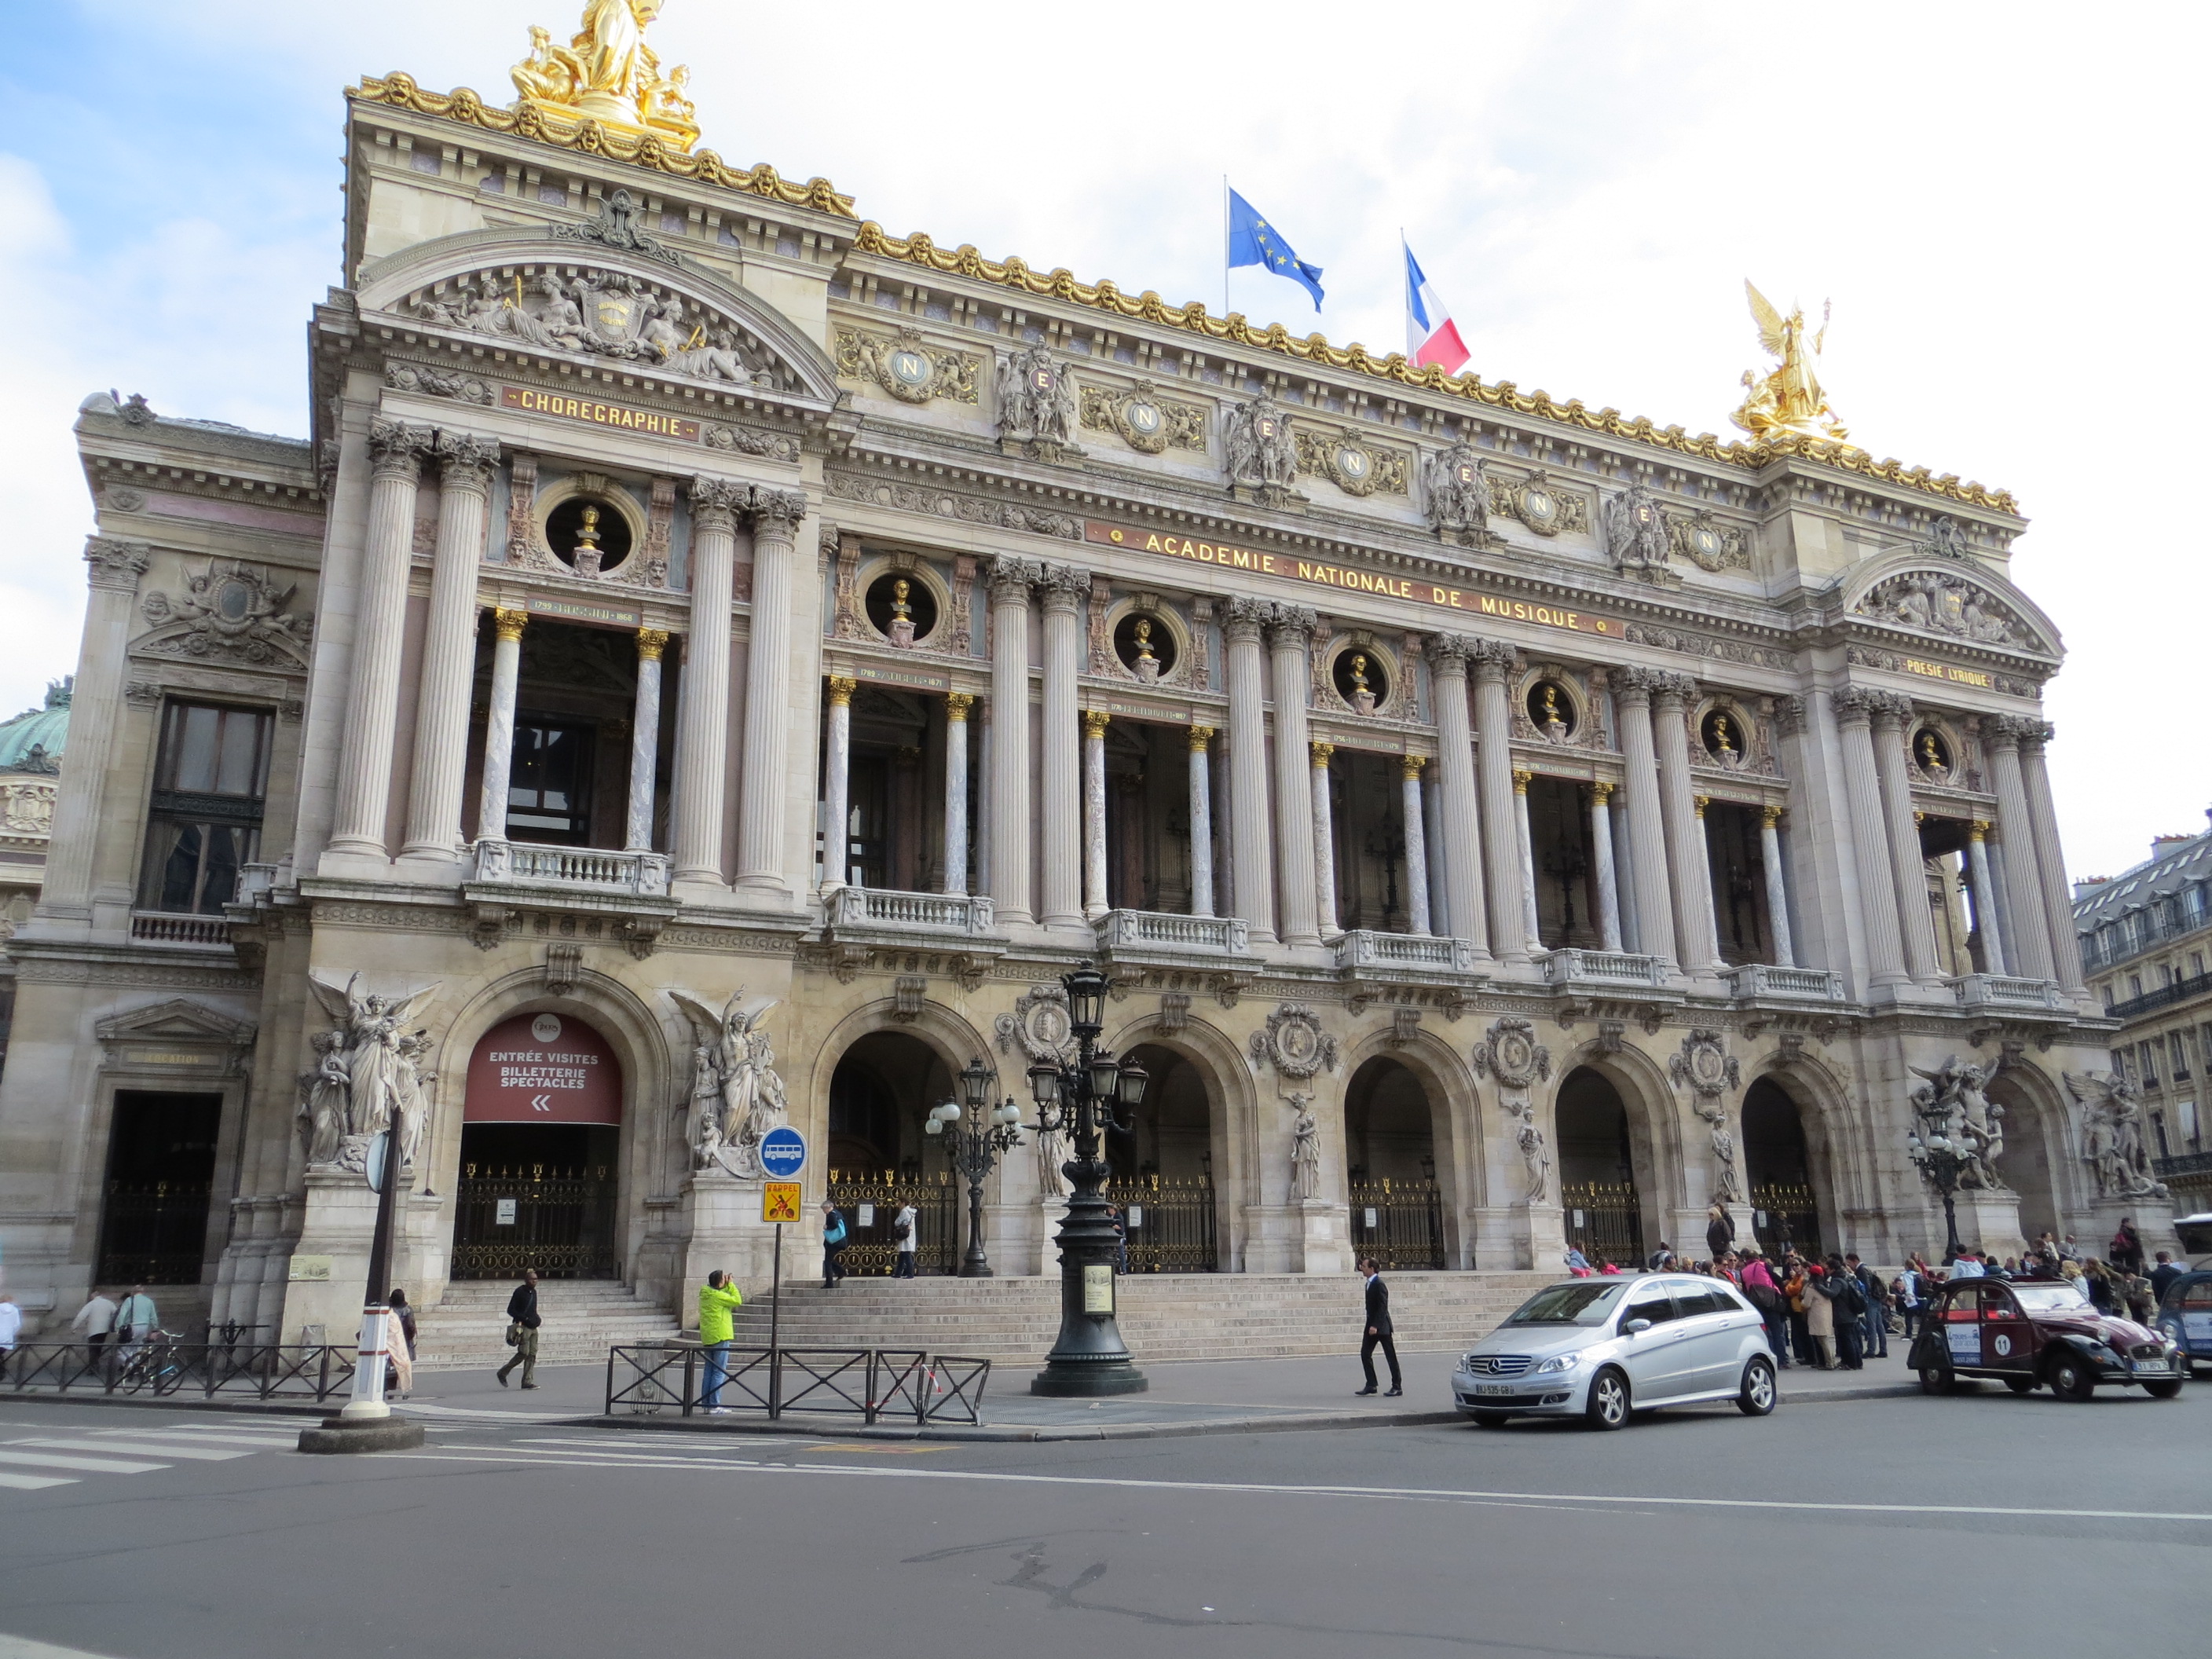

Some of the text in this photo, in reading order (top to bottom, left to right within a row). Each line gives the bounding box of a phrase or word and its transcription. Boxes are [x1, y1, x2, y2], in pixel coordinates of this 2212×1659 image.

[903, 357, 917, 375] N
[1038, 372, 1049, 387] E
[521, 390, 681, 436] CHOREGRAPHIE
[1138, 408, 1152, 425] N
[1263, 422, 1273, 436] E
[1348, 455, 1360, 471] N
[1462, 467, 1471, 482] E
[1534, 496, 1547, 512] N
[1639, 508, 1650, 522] E
[1701, 534, 1712, 548] N
[1145, 533, 1579, 629] ACADEMIE NATIONALE DE MUSIQUE
[616, 613, 632, 621] 1868
[1906, 658, 1989, 687] POESIE LYRIQUE
[928, 678, 942, 687] 1871
[489, 1049, 599, 1064] ENTRÉE VISITES
[501, 1067, 586, 1079] BILLETTERIE
[500, 1077, 584, 1090] SPECTACLES
[767, 1184, 798, 1192] RAPPEL
[1998, 1339, 2007, 1350] 11
